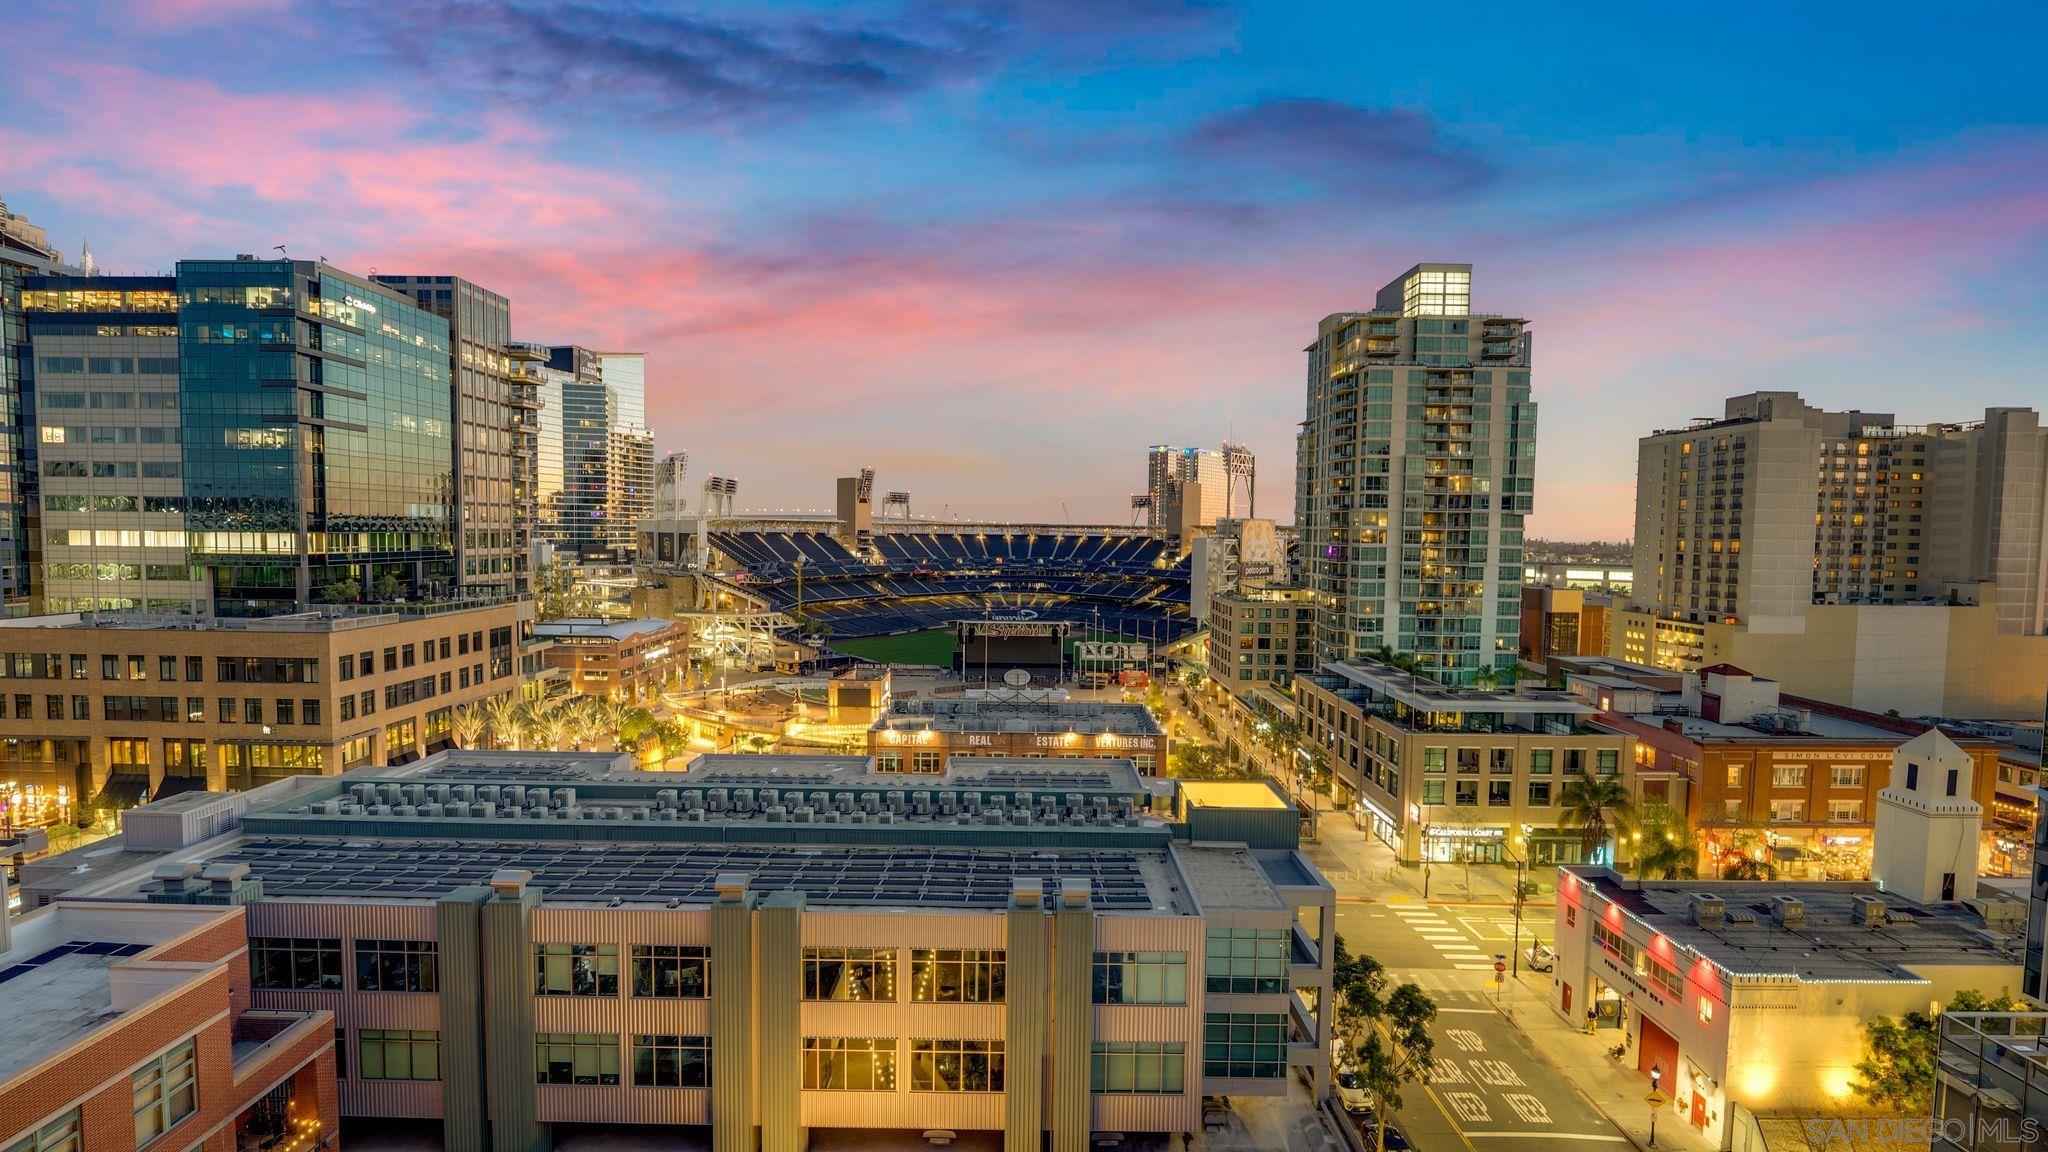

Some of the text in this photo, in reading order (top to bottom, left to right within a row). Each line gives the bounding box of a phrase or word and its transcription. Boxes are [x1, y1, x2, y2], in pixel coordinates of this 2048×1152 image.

[889, 733, 1157, 749] CAPITAL REAL ESTATE VENTURES INC.
[1620, 970, 1648, 994] STATION
[1445, 1029, 1487, 1052] STOP
[1468, 1060, 1526, 1086] CLEAR
[1443, 1092, 1493, 1122] KEEP
[1501, 1093, 1553, 1124] KEEP
